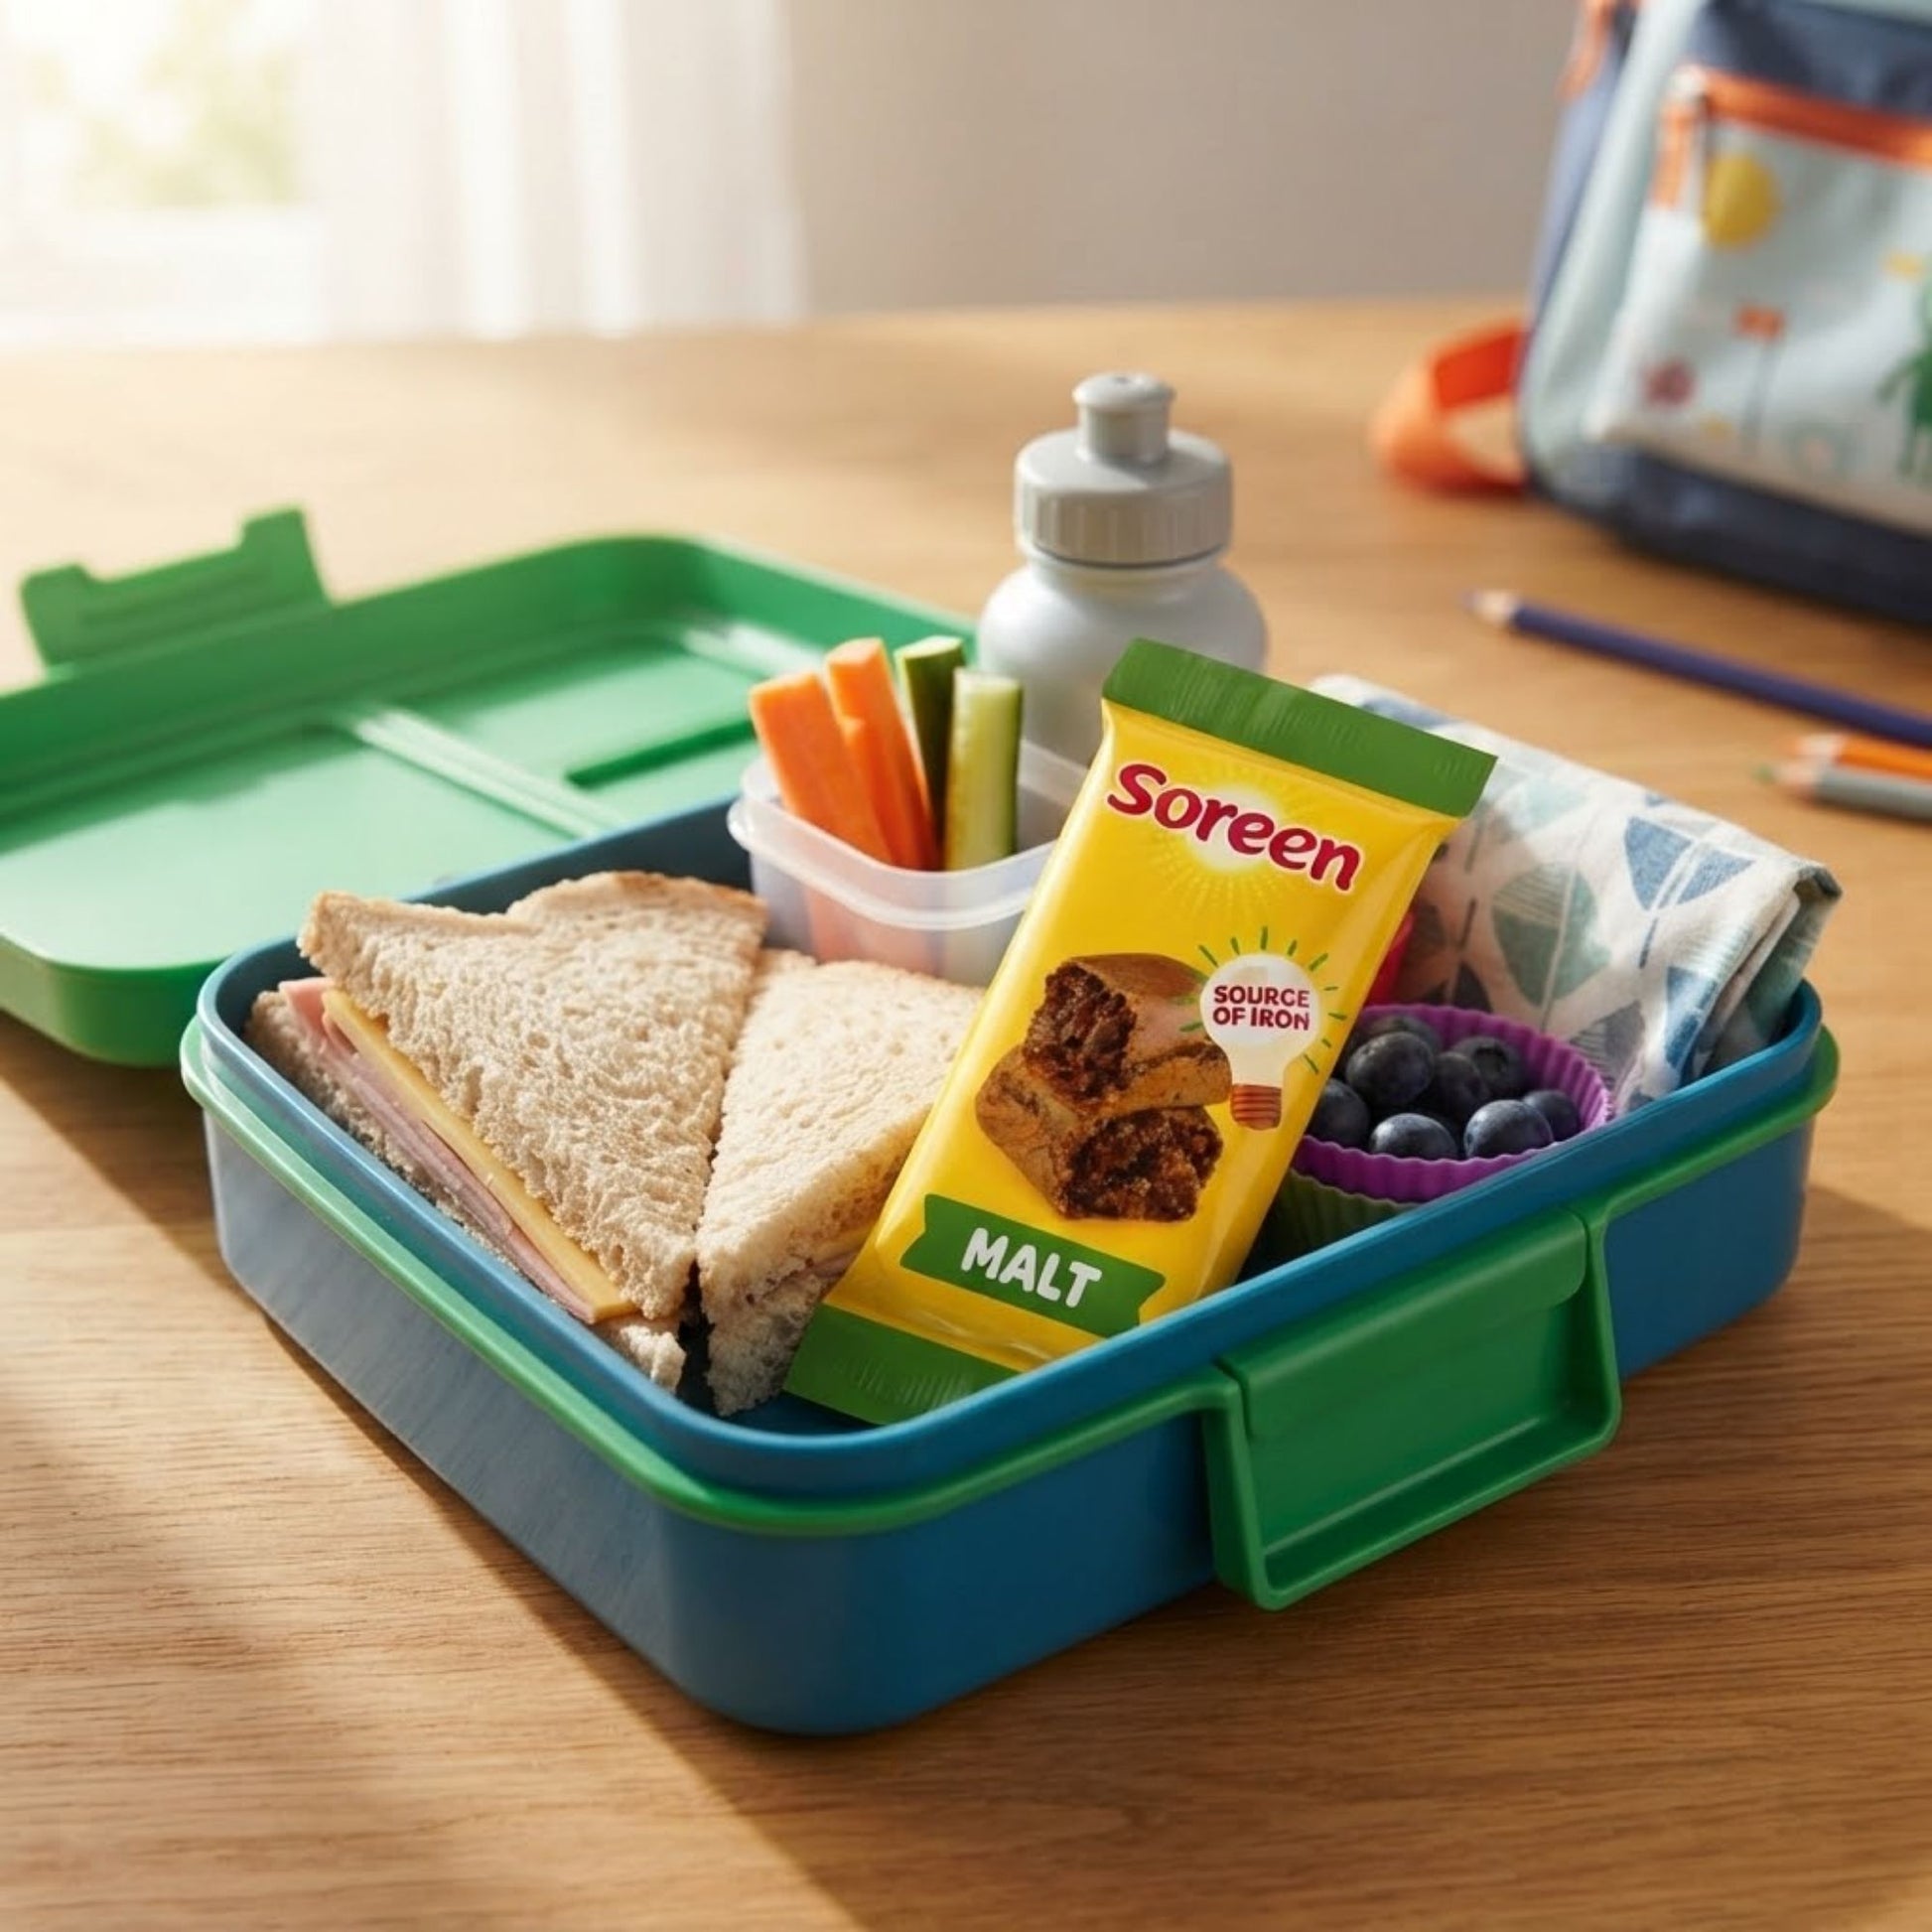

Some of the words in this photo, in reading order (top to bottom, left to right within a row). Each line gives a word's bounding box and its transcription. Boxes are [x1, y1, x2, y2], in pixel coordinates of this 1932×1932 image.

[1106, 762, 1361, 892] Soreen
[1212, 1006, 1246, 1026] OF
[1250, 1007, 1311, 1032] IRON
[1213, 984, 1311, 1009] SOURCE
[960, 1227, 1102, 1309] MALT
